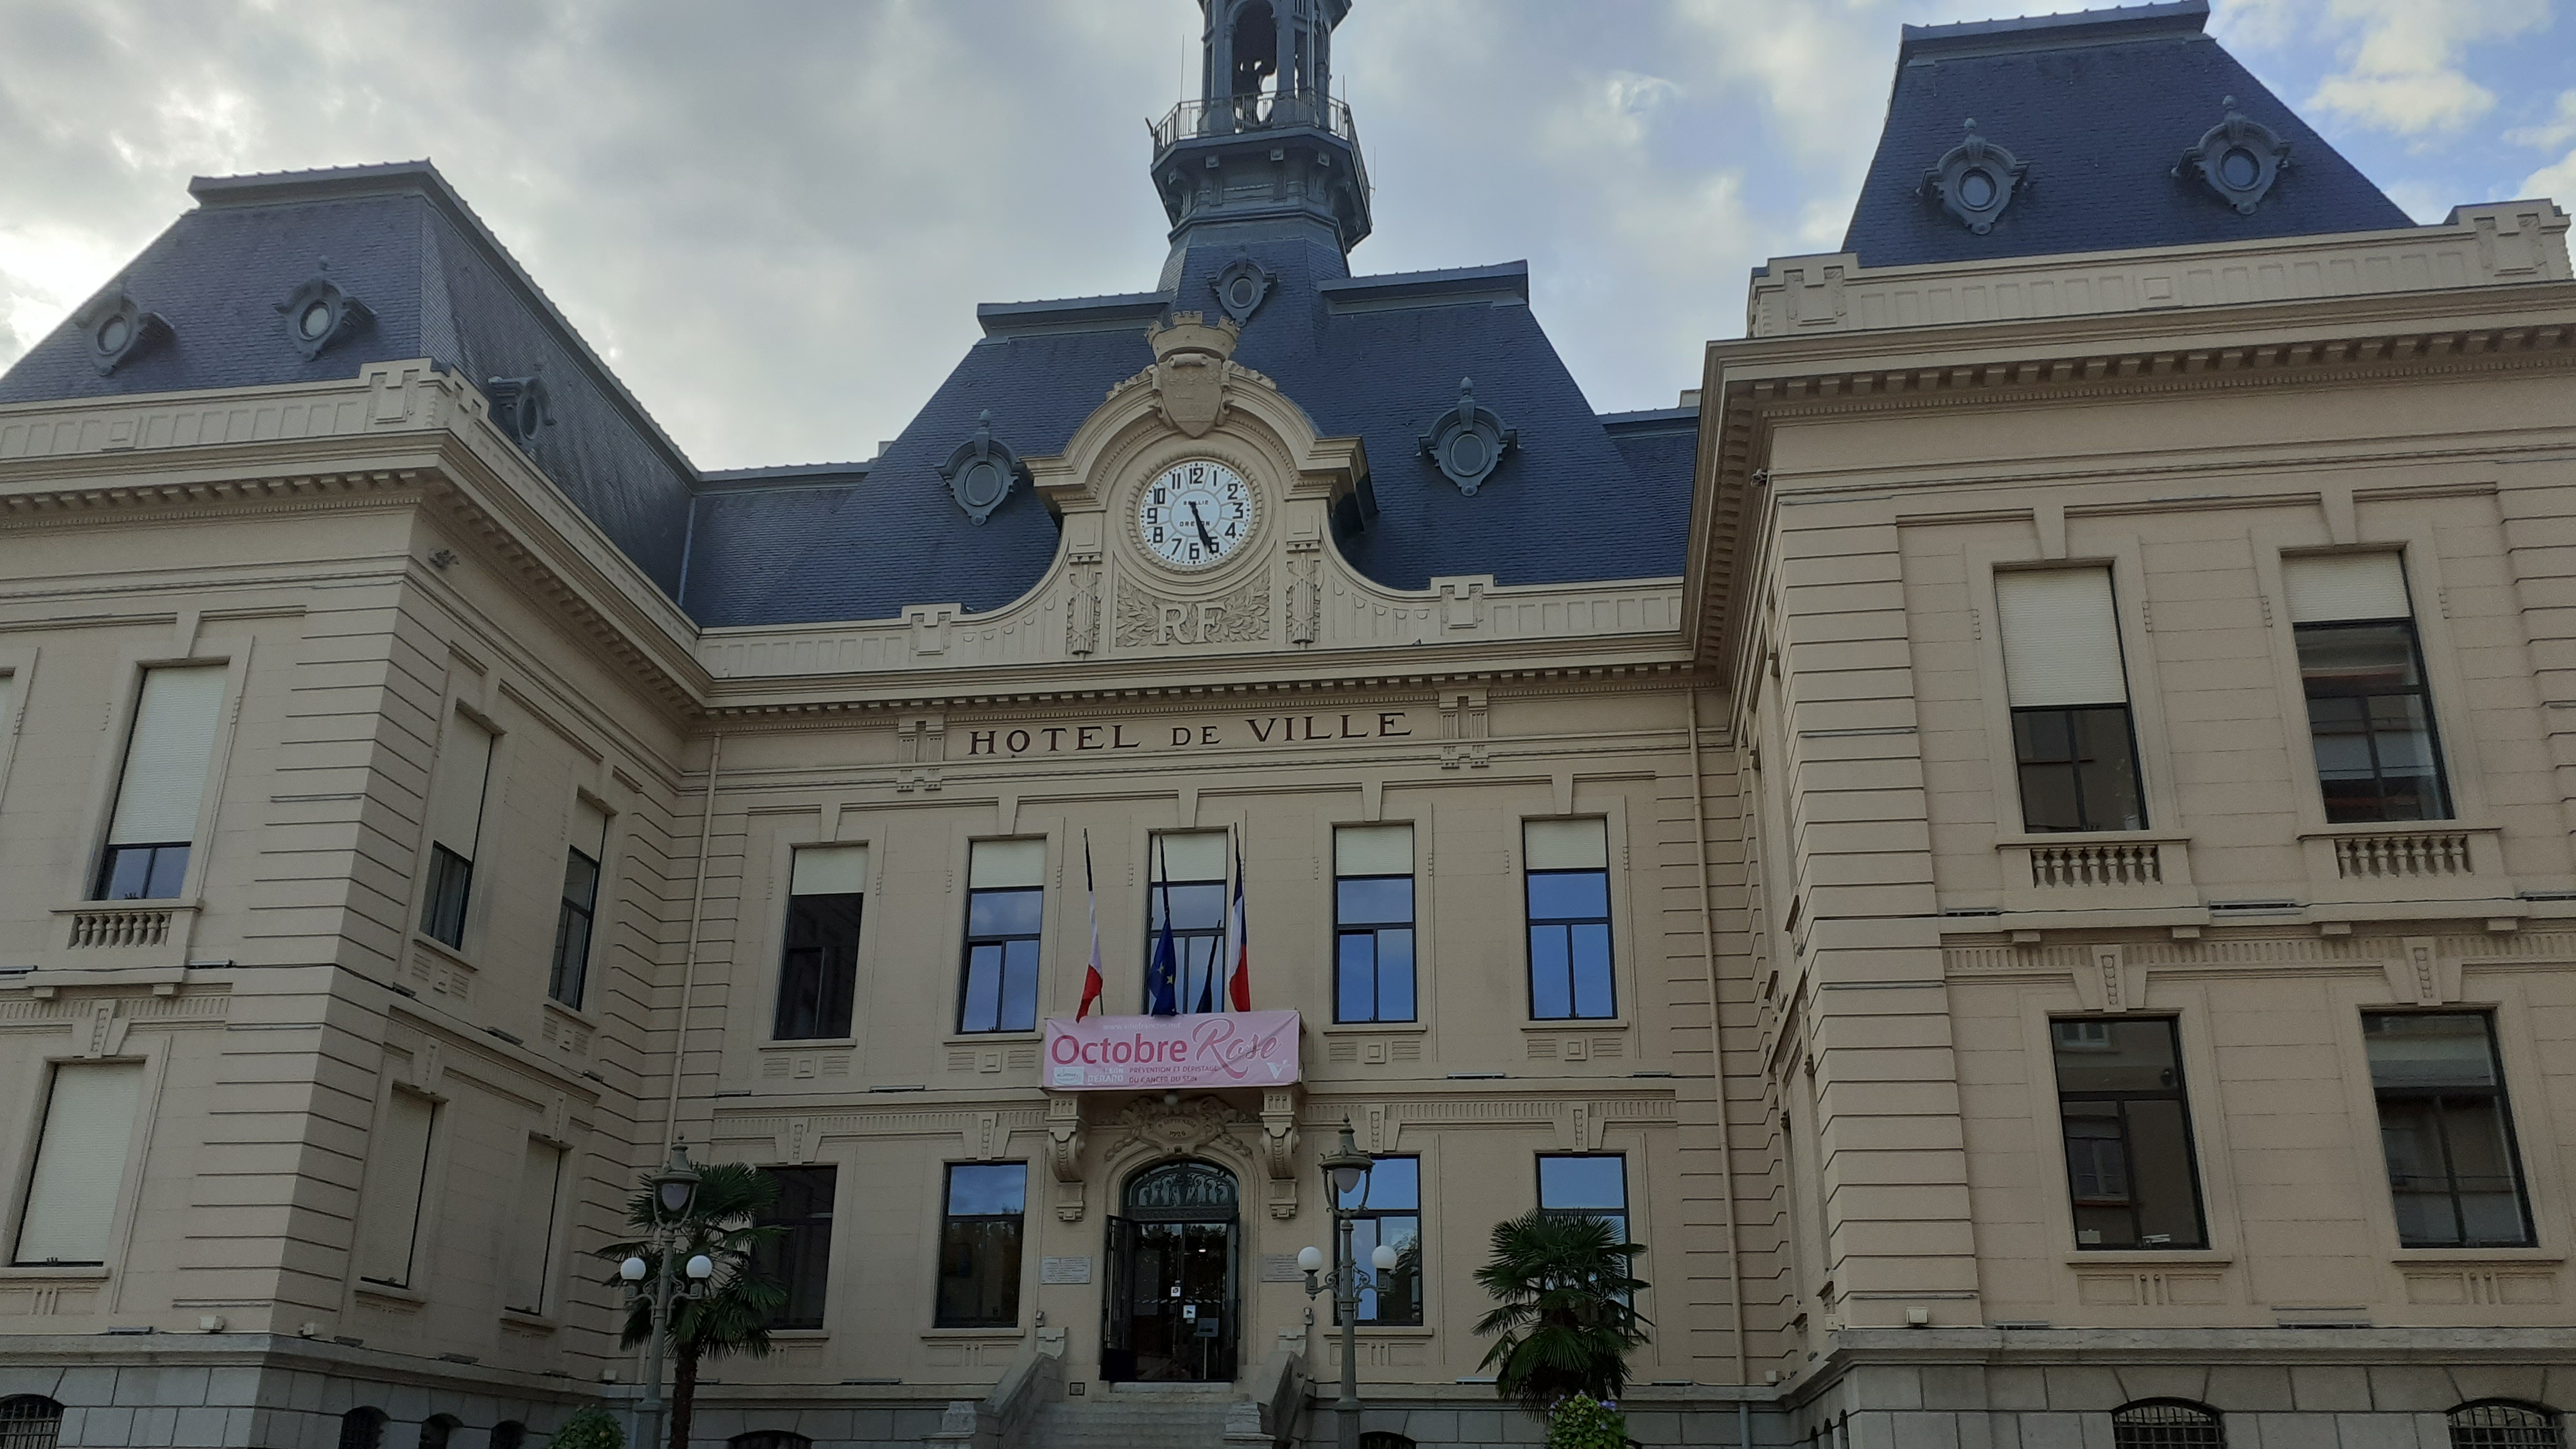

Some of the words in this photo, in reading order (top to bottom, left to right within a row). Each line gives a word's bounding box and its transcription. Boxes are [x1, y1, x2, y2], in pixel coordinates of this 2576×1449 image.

[1172, 472, 1181, 490] 11
[1189, 467, 1204, 484] 12
[1213, 470, 1217, 487] 1
[1153, 487, 1166, 504] 10
[1227, 484, 1238, 500] 2
[1147, 507, 1158, 524] 9
[1232, 502, 1244, 519] 3
[1153, 526, 1163, 544] 8
[1224, 522, 1236, 539] 4
[1171, 538, 1182, 555] 7
[1189, 542, 1199, 560] 6
[968, 725, 1141, 755] HOTEL
[1170, 726, 1222, 747] DE
[1245, 712, 1413, 743] VILLE
[1051, 1033, 1188, 1065] Octobre
[1192, 1018, 1282, 1080] Rose
